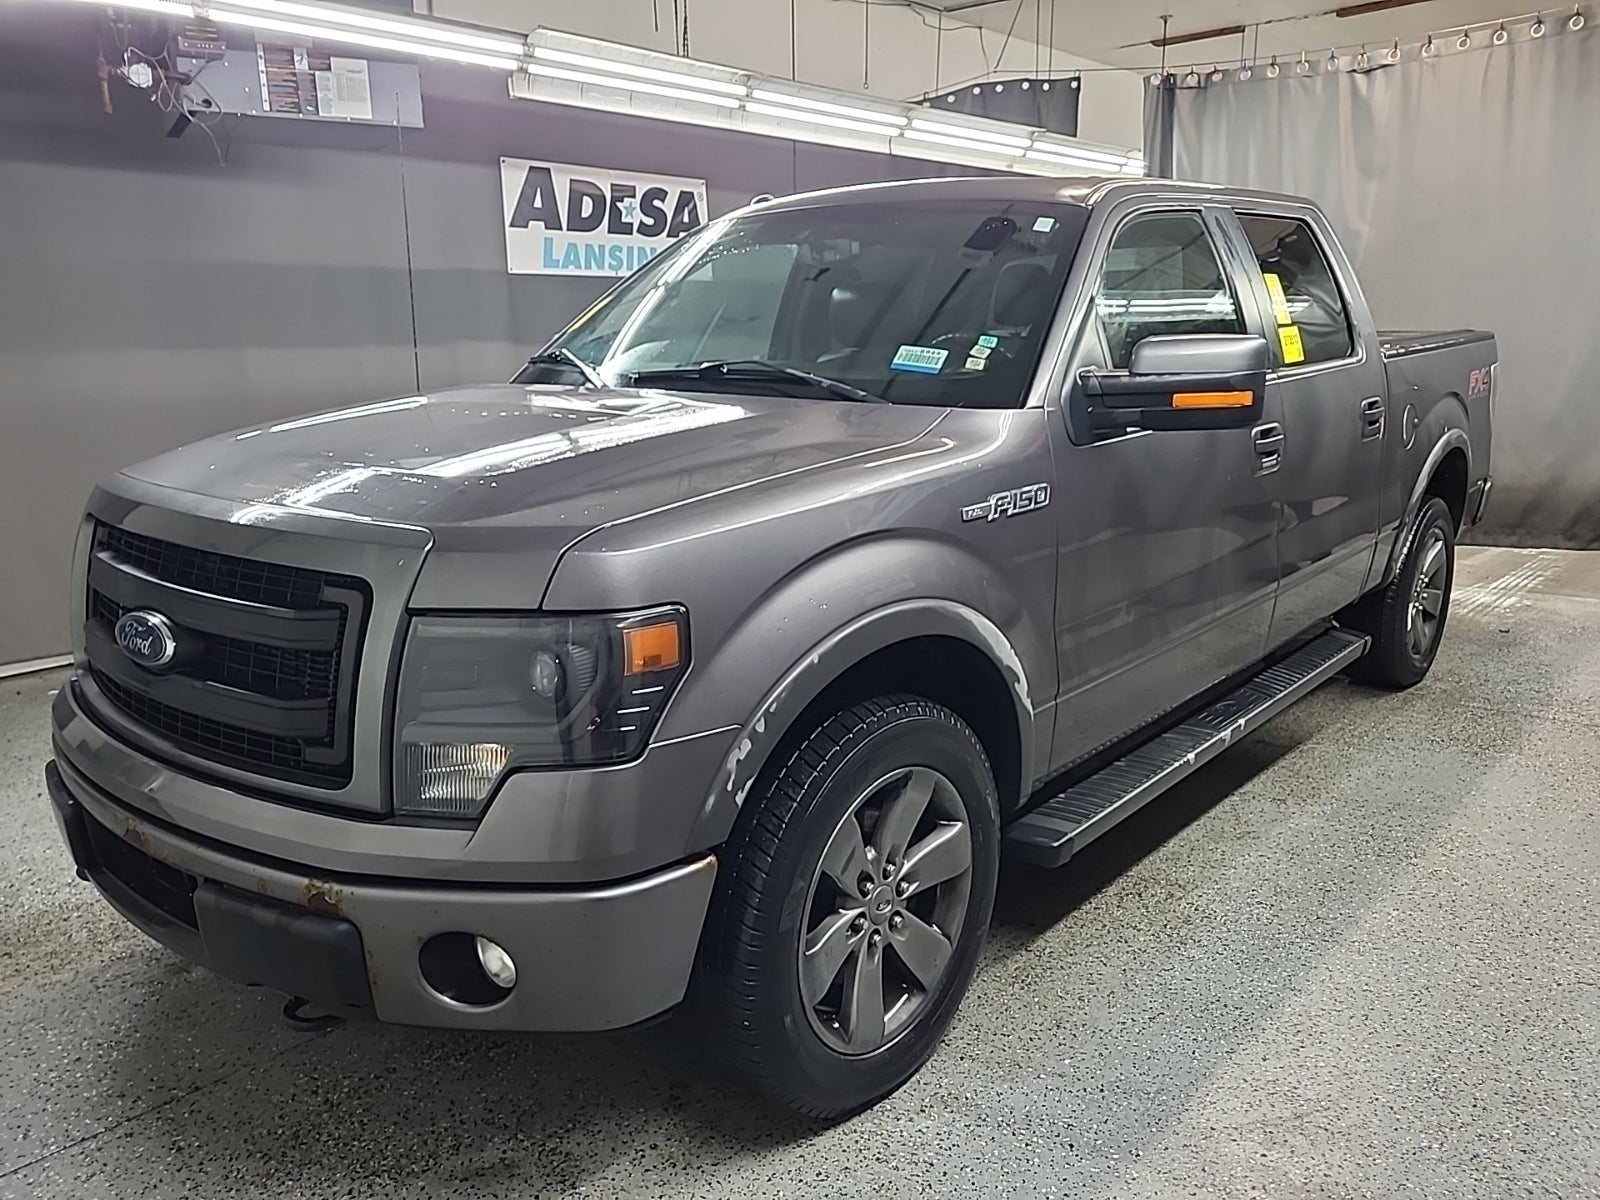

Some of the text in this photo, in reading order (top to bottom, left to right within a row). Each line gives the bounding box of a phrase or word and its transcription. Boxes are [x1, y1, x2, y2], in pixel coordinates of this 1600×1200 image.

[509, 166, 701, 238] ADESA
[543, 237, 658, 271] LANSIN
[122, 620, 153, 655] Ford
